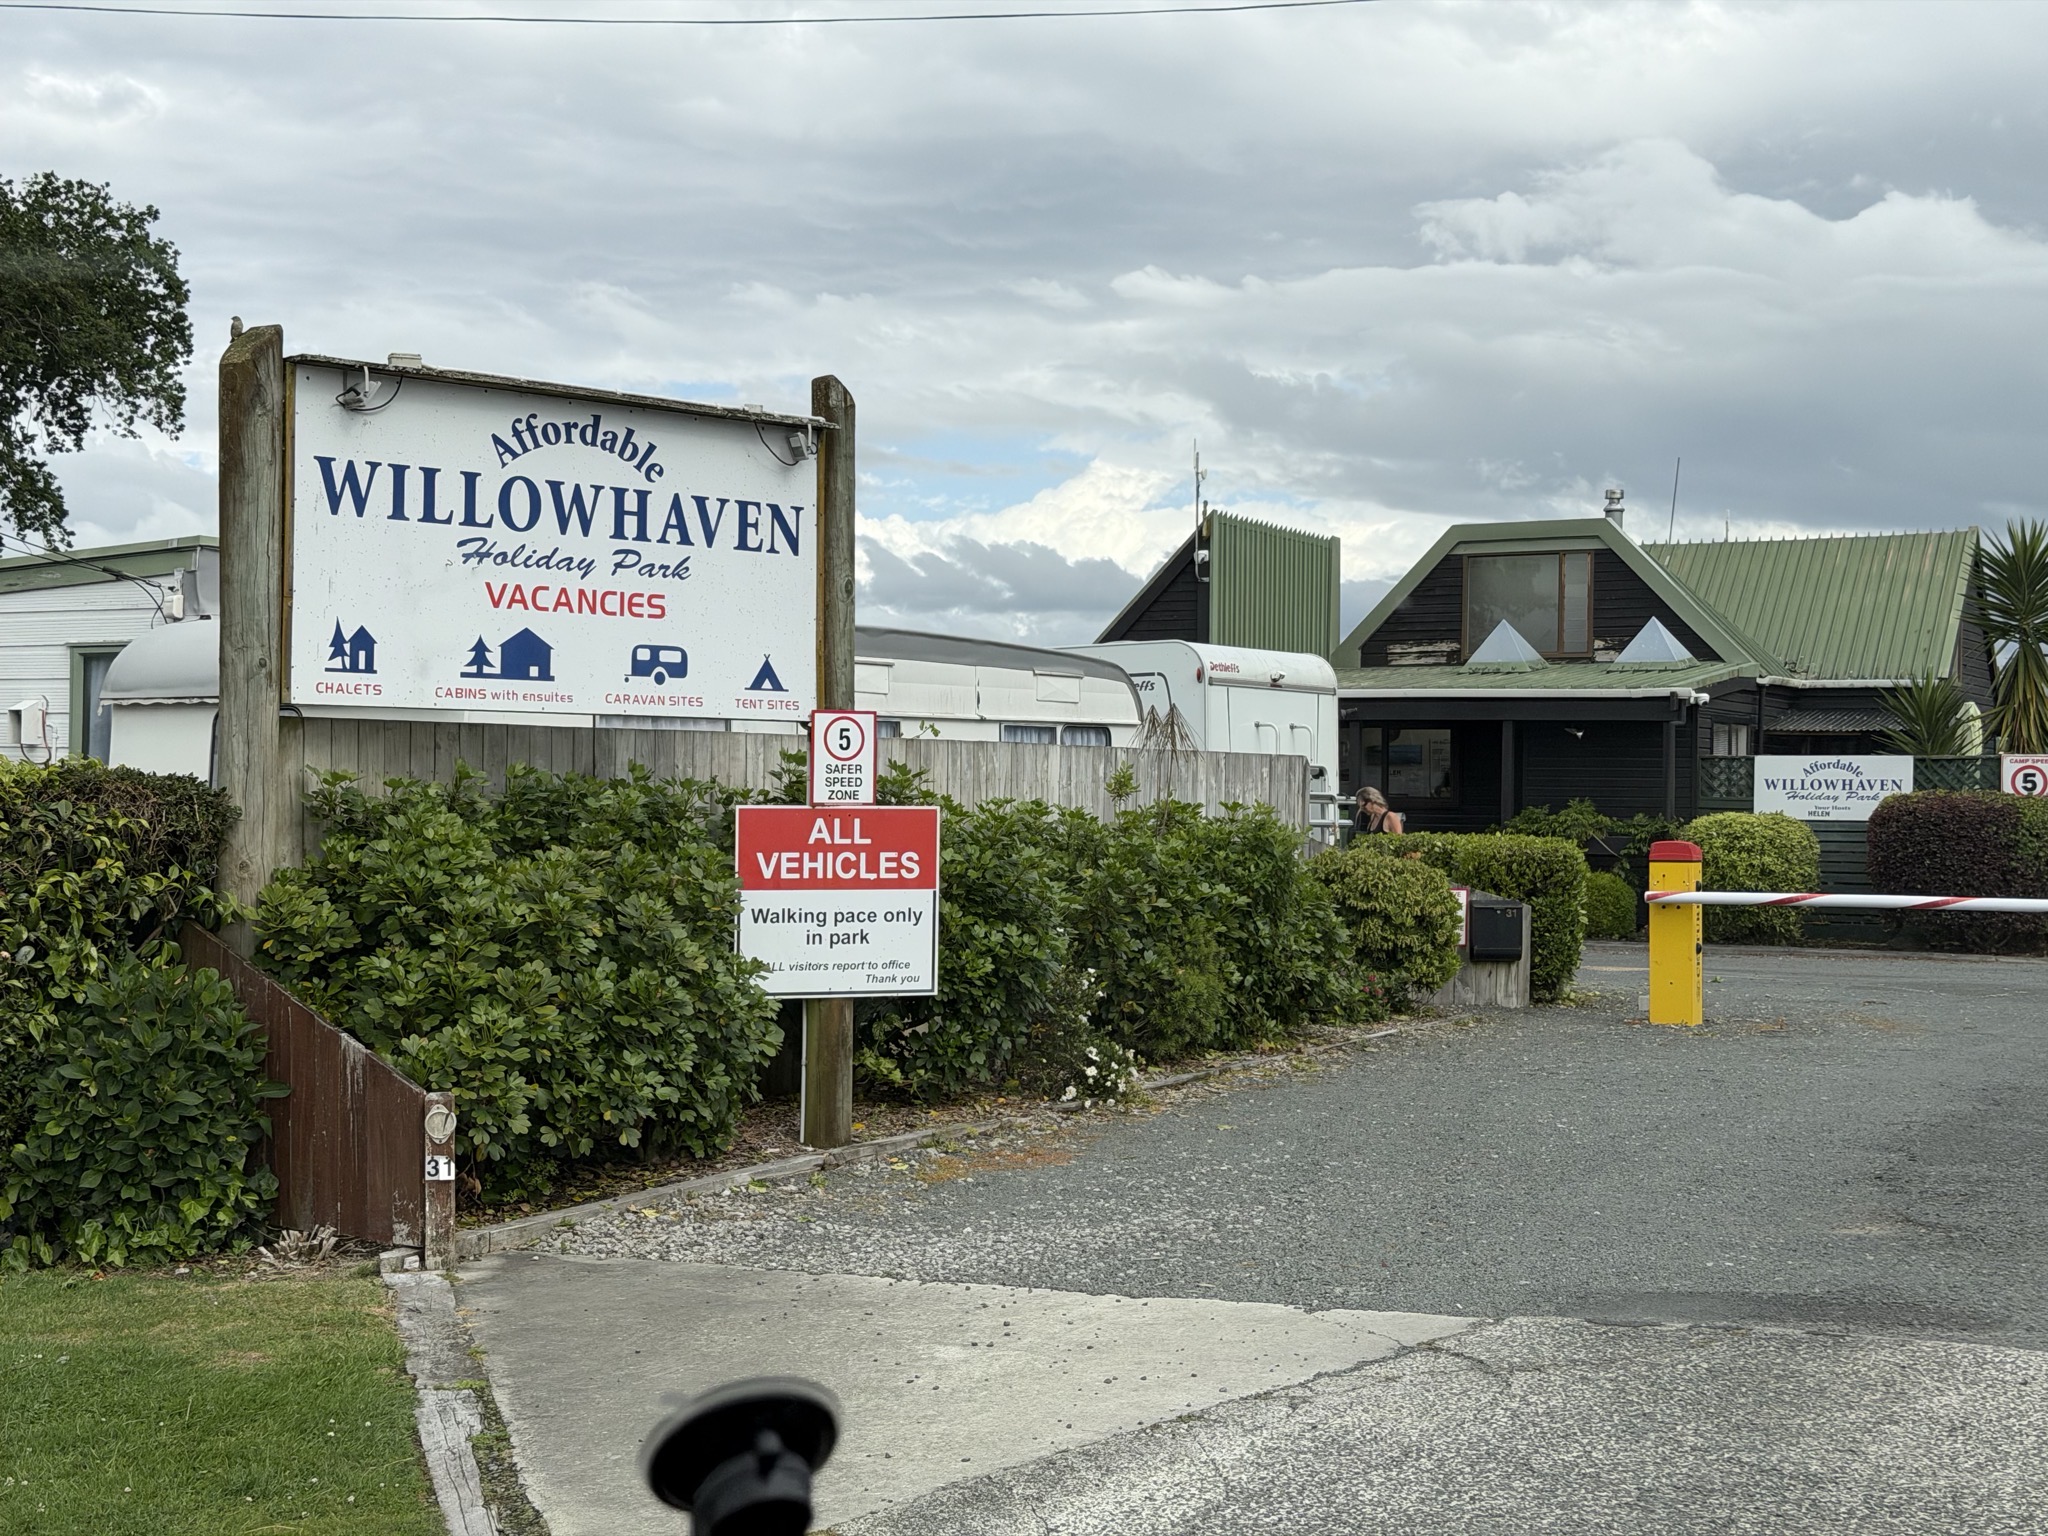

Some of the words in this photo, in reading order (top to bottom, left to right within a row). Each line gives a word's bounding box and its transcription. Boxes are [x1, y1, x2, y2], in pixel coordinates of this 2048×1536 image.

[490, 413, 665, 484] Affordable
[313, 455, 805, 557] WILLOWHAVEN
[456, 537, 597, 581] Holiday
[610, 548, 693, 581] Park
[484, 581, 667, 619] VACANCIES
[1209, 661, 1240, 673] Dethleffs
[315, 682, 383, 696] CHALETS
[435, 687, 487, 700] CABINS
[491, 689, 519, 702] with
[522, 691, 574, 703] ensuites
[604, 693, 666, 707] CARAVAN
[668, 694, 704, 708] SITES
[735, 698, 764, 710] TENT
[767, 699, 800, 711] SITES
[838, 727, 851, 751] 5
[825, 763, 863, 775] SAFER
[1802, 758, 1864, 778] Affordable
[824, 776, 863, 788] SPEED
[1763, 778, 1904, 792] WILLOWHAVEN
[2021, 772, 2037, 792] 5
[827, 789, 860, 801] ZONE
[1785, 790, 1840, 803] Holiday
[1845, 791, 1880, 802] Park
[807, 818, 872, 845] ALL
[756, 851, 921, 880] VEHICLES
[751, 907, 827, 927] Walking
[833, 909, 878, 927] pace
[884, 907, 923, 926] only
[1505, 908, 1517, 918] 31
[806, 929, 823, 946] in
[829, 928, 870, 949] park
[765, 961, 785, 972] LL
[789, 961, 829, 972] visitors
[832, 961, 865, 973] report
[866, 961, 879, 971] to
[881, 960, 911, 970] office
[865, 974, 897, 984] Thank
[900, 975, 920, 986] you
[426, 1158, 452, 1177] 31
